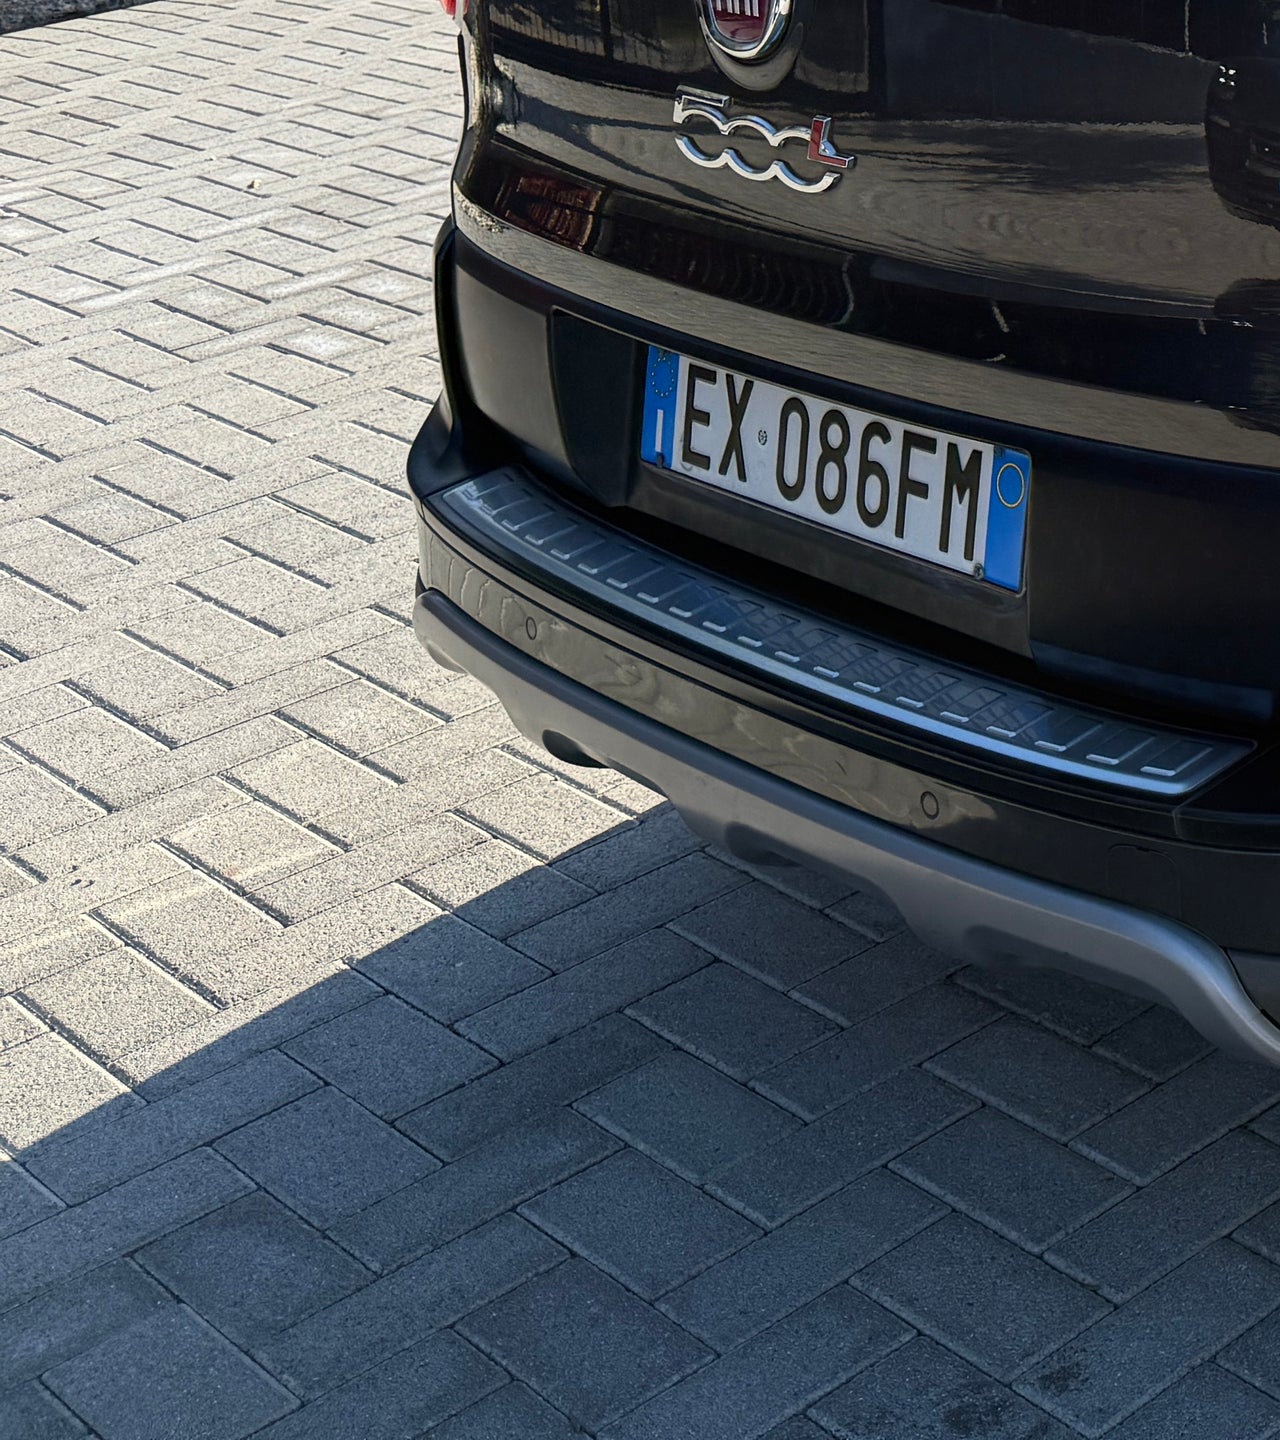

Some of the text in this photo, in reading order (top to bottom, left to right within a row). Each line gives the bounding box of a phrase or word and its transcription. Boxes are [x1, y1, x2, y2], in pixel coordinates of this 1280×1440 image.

[672, 84, 855, 194] 500L
[682, 363, 753, 482] EX
[776, 397, 983, 561] 086FM
